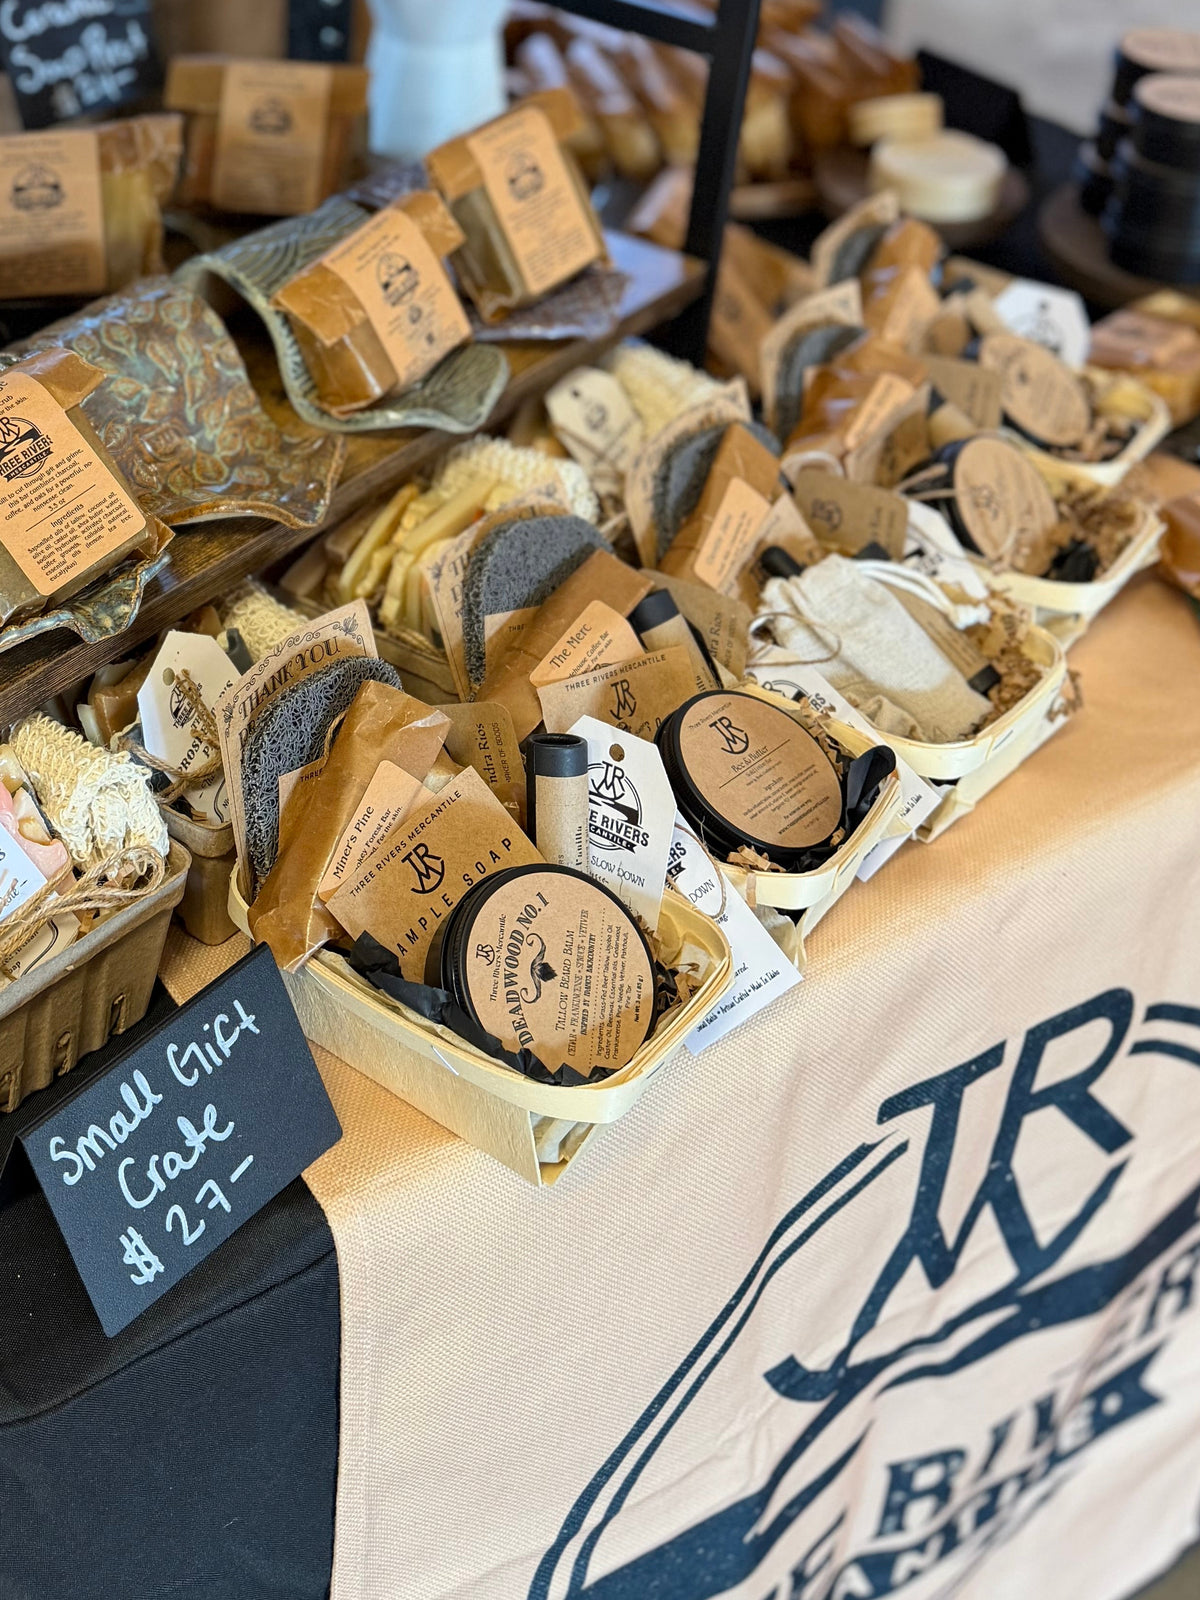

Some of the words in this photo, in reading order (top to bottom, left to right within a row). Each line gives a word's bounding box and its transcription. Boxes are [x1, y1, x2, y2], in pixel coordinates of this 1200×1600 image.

[0, 454, 22, 475] HREE
[23, 473, 46, 489] through
[29, 476, 55, 495] combines
[50, 504, 84, 528] Ingredients
[549, 649, 571, 666] The
[566, 624, 592, 648] Merc
[239, 660, 299, 719] THANK
[295, 637, 341, 671] YOU
[565, 679, 590, 691] THREE
[593, 669, 618, 682] RIVERS
[619, 654, 666, 674] MERCANTILE
[476, 723, 489, 750] Rios
[493, 722, 502, 746] GOODS
[500, 748, 506, 757] OF
[731, 762, 745, 773] Bee
[748, 745, 768, 761] Butter
[484, 755, 497, 783] ndra
[356, 848, 368, 868] okey
[365, 823, 383, 848] Forest
[380, 808, 391, 822] Bar
[384, 822, 392, 833] the
[589, 825, 631, 848] CANTILE
[601, 815, 649, 847] RIVERS
[333, 835, 357, 879] Miner's
[354, 806, 374, 833] Pine
[350, 870, 376, 897] THREE
[376, 840, 407, 871] RIVERS
[407, 790, 461, 841] MERCANTILE
[590, 855, 616, 873] SLOW
[617, 867, 645, 887] DOWN
[397, 893, 453, 956] AMPLE
[462, 838, 511, 889] SOAP
[688, 879, 715, 903] DOWN
[516, 903, 542, 931] NO.
[496, 914, 506, 953] Mercantile
[563, 930, 574, 955] BALM
[492, 953, 501, 978] Rivers
[559, 958, 571, 989] BEARD
[490, 979, 498, 1001] Three
[503, 929, 536, 1049] DEADWOOD
[567, 1034, 577, 1056] CEDAR
[578, 909, 588, 938] VETIVER
[609, 971, 617, 999] Essential
[733, 989, 750, 1004] Crafted
[750, 982, 763, 991] Made
[555, 992, 568, 1031] TALLOW
[50, 1069, 163, 1186] Small
[167, 999, 261, 1087] Gift
[118, 1103, 235, 1209] Crate
